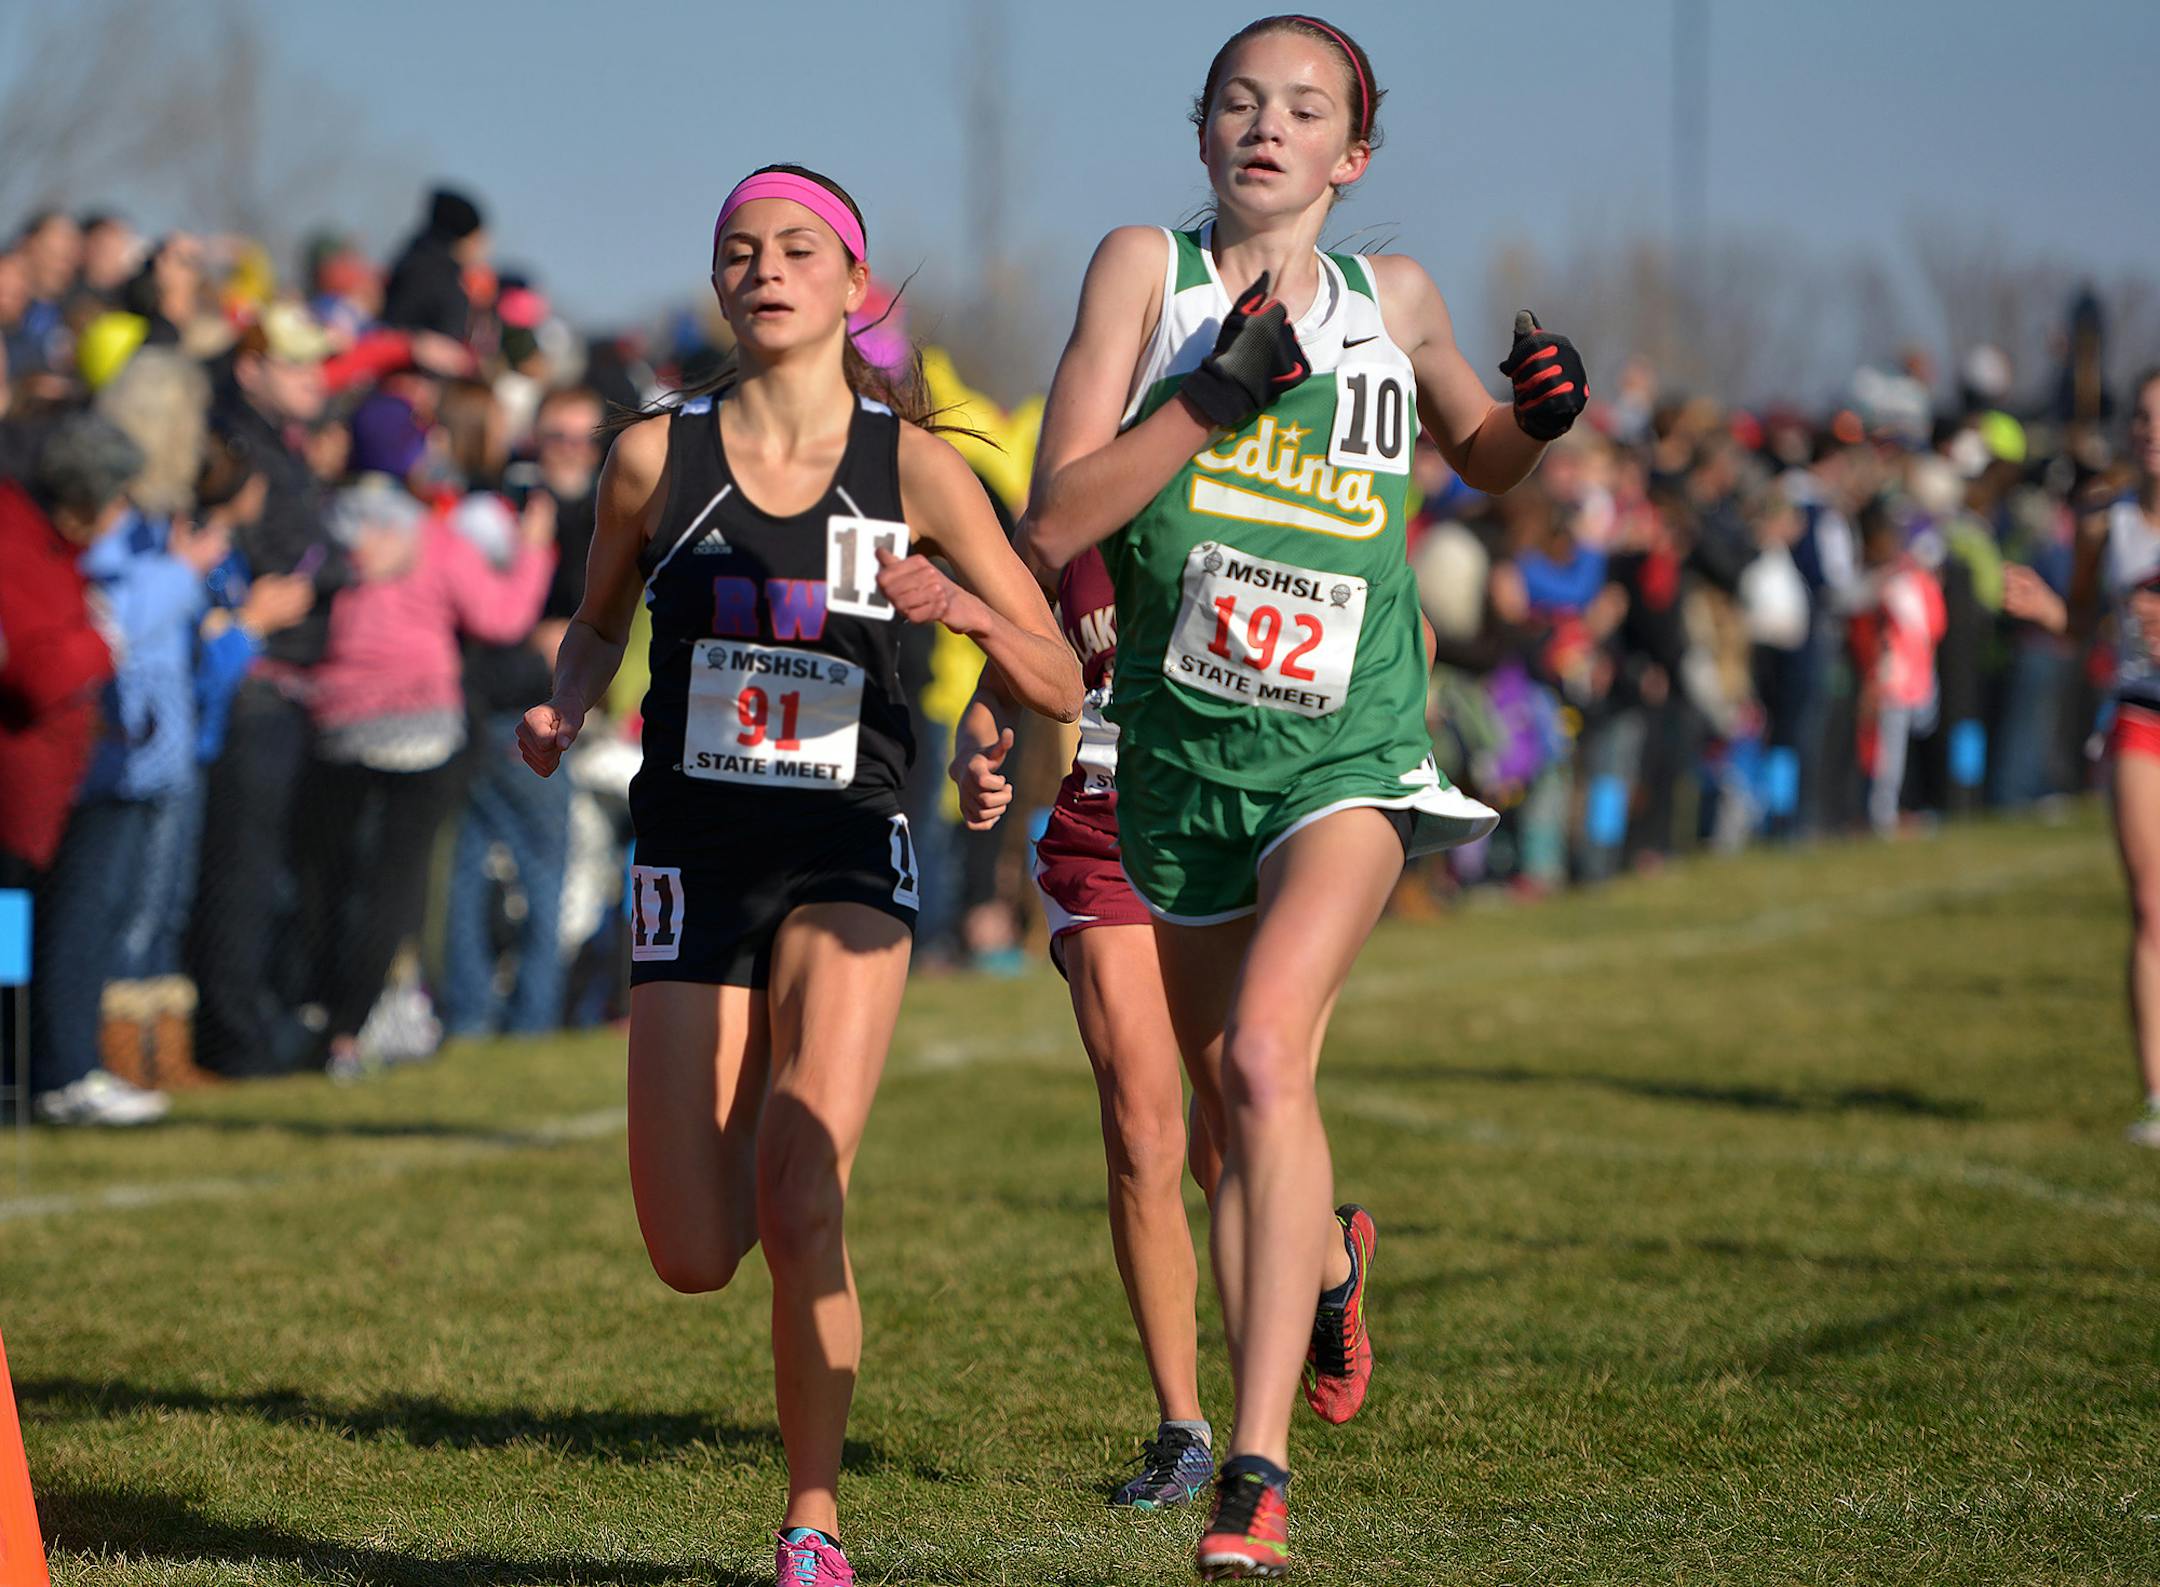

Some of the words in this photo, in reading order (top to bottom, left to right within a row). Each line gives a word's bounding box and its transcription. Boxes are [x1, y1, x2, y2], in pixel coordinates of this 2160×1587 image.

[1340, 372, 1403, 459] 10
[711, 576, 829, 641] RW
[1226, 560, 1325, 602] MSHSL
[1068, 604, 1118, 664] LAK
[1208, 595, 1324, 682] 192
[730, 651, 825, 681] MSHSL
[1180, 654, 1252, 694] STATE
[1258, 683, 1331, 711] MEET
[736, 685, 801, 752] 91
[697, 752, 767, 775] STATE
[774, 760, 842, 781] MEET
[634, 872, 676, 946] 11
